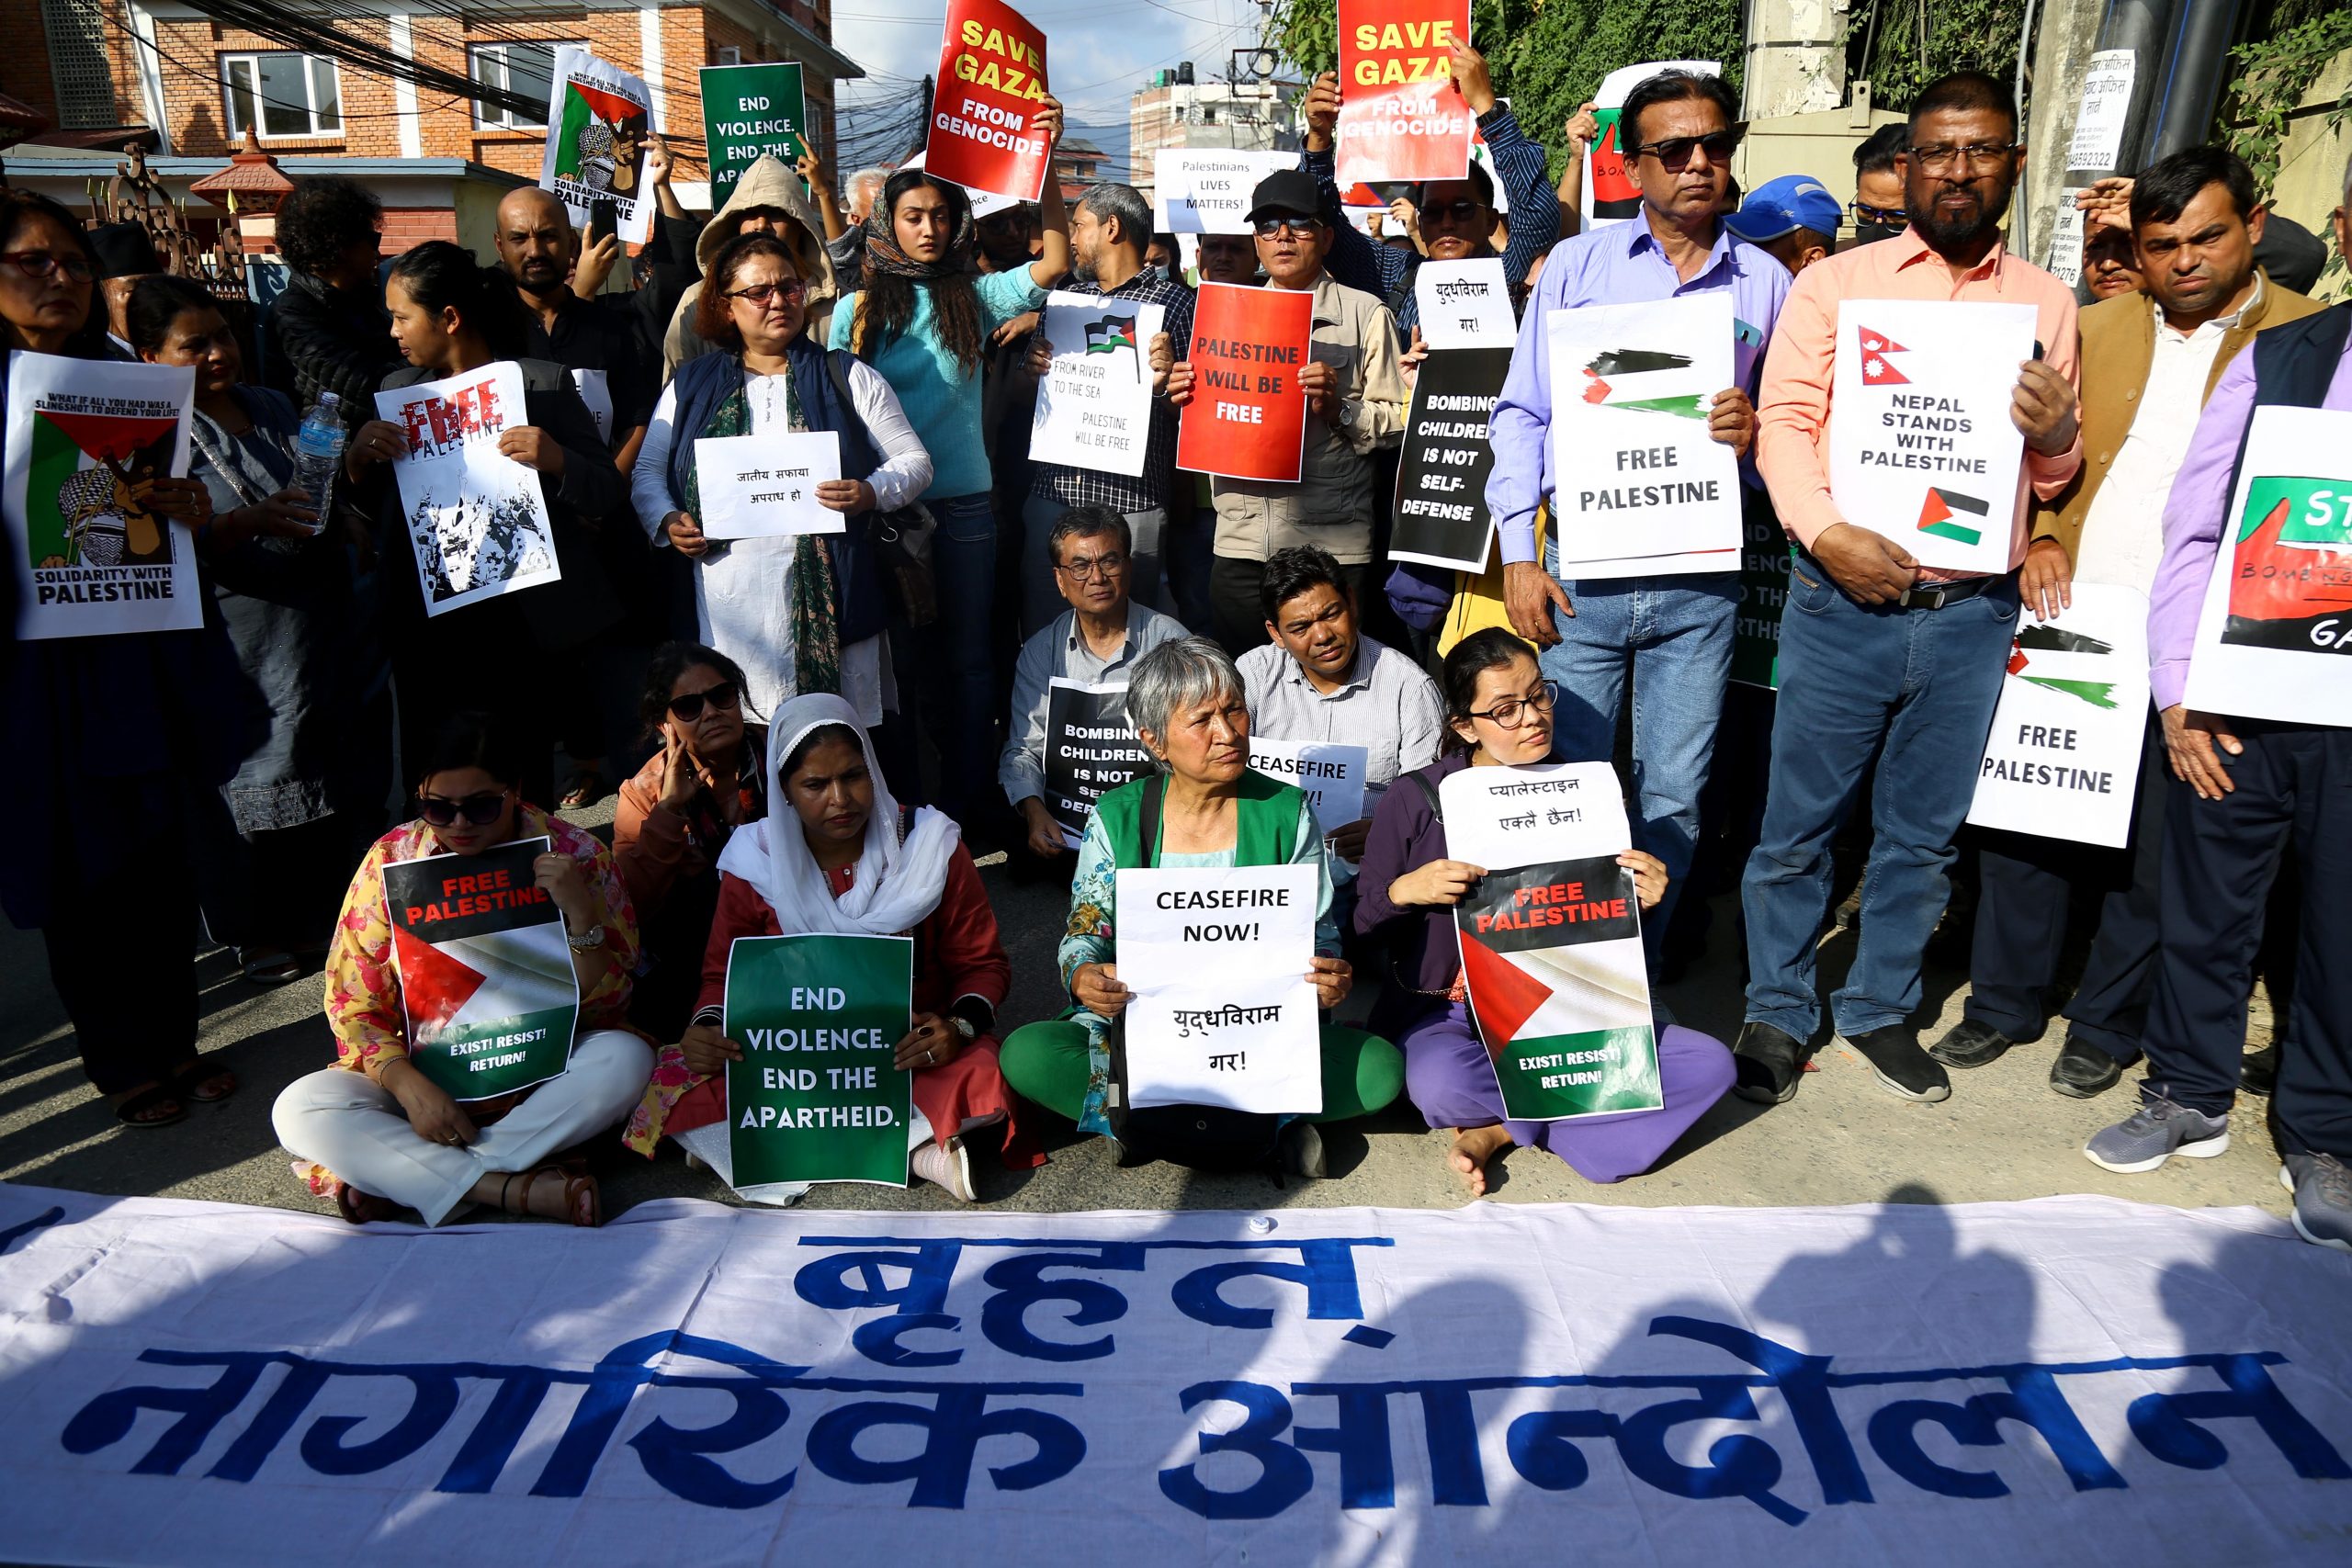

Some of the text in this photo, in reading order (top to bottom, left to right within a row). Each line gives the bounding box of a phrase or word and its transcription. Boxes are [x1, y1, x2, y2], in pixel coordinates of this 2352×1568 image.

[1355, 20, 1453, 51] SAVE
[961, 19, 1041, 75] SAVE
[956, 53, 1045, 104] GAZA
[1354, 55, 1452, 85] GAZA
[739, 96, 770, 112] END
[961, 98, 1023, 131] FROM
[1372, 99, 1437, 117] FROM
[716, 118, 796, 137] VIOLENCE.
[935, 112, 1046, 156] GENOCIDE
[1343, 118, 1464, 139] GENOCIDE
[727, 142, 791, 160] END THE
[1182, 161, 1250, 173] Palestinians
[554, 179, 608, 199] SOLIDARITY
[1200, 180, 1230, 190] LIVES
[553, 187, 633, 221] PALENE
[1186, 198, 1244, 209] MATTERS!
[1459, 317, 1479, 333] गर!
[1196, 336, 1299, 364] PALESTINE
[1054, 360, 1105, 380] FROM RIVER
[1055, 380, 1101, 399] TO THE SEA
[1204, 369, 1283, 394] WILL BE
[35, 400, 89, 413] SLINGSHOT
[91, 405, 103, 413] TO
[104, 407, 137, 416] DEFEND
[140, 408, 162, 417] YOUR
[48, 393, 78, 403] WHAT
[79, 396, 88, 404] IF
[90, 398, 106, 406] ALL
[108, 399, 127, 407] YOU
[128, 400, 146, 409] HAD
[148, 400, 165, 410] WAS
[1216, 400, 1263, 424] FREE
[1892, 394, 1966, 413] NEPAL
[399, 378, 503, 450] FREE
[1082, 412, 1128, 431] PALESTINE
[1882, 412, 1973, 434] STANDS
[411, 415, 504, 461] PALESTINE
[1075, 432, 1130, 451] WILL BE FREE
[1896, 434, 1954, 453] WITH
[1422, 447, 1478, 467] IS NOT
[1616, 446, 1679, 472] FREE
[1860, 450, 1987, 474] PALESTINE
[737, 468, 809, 482] जातीय सफाया
[1420, 474, 1465, 492] SELF-
[750, 489, 801, 504] अपराध हो
[1580, 479, 1720, 512] PALESTINE
[1401, 499, 1474, 522] DEFENSE
[35, 567, 173, 584] SOLIDARITY WITH
[38, 580, 175, 605] PALESTINE
[2018, 724, 2077, 751] FREE
[1060, 745, 1149, 762] CHILDREN
[1073, 768, 1134, 784] IS NOT
[1248, 754, 1347, 780] CEASEFIRE
[1982, 758, 2113, 795] PALESTINE
[1488, 778, 1579, 797] प्यालेस्टाइन
[1498, 807, 1582, 831] एक्लै छैन!
[442, 869, 511, 897] FREE
[404, 886, 548, 926] PALESTINE
[1156, 888, 1290, 910] CEASEFIRE
[1515, 882, 1585, 908] FREE
[1476, 897, 1629, 934] PALESTINE
[1183, 922, 1260, 942] NOW!
[791, 987, 846, 1011] END
[449, 1028, 548, 1057] EXIST! RESIST!
[745, 1028, 890, 1052] VIOLENCE.
[469, 1051, 526, 1072] RETURN!
[1209, 1051, 1247, 1072] गर!
[1519, 1047, 1621, 1071] EXIST! RESIST!
[763, 1066, 877, 1090] END THE
[1541, 1070, 1602, 1090] RETURN!
[740, 1105, 900, 1129] APARTHEID.
[62, 1329, 1088, 1510] नागरिक
